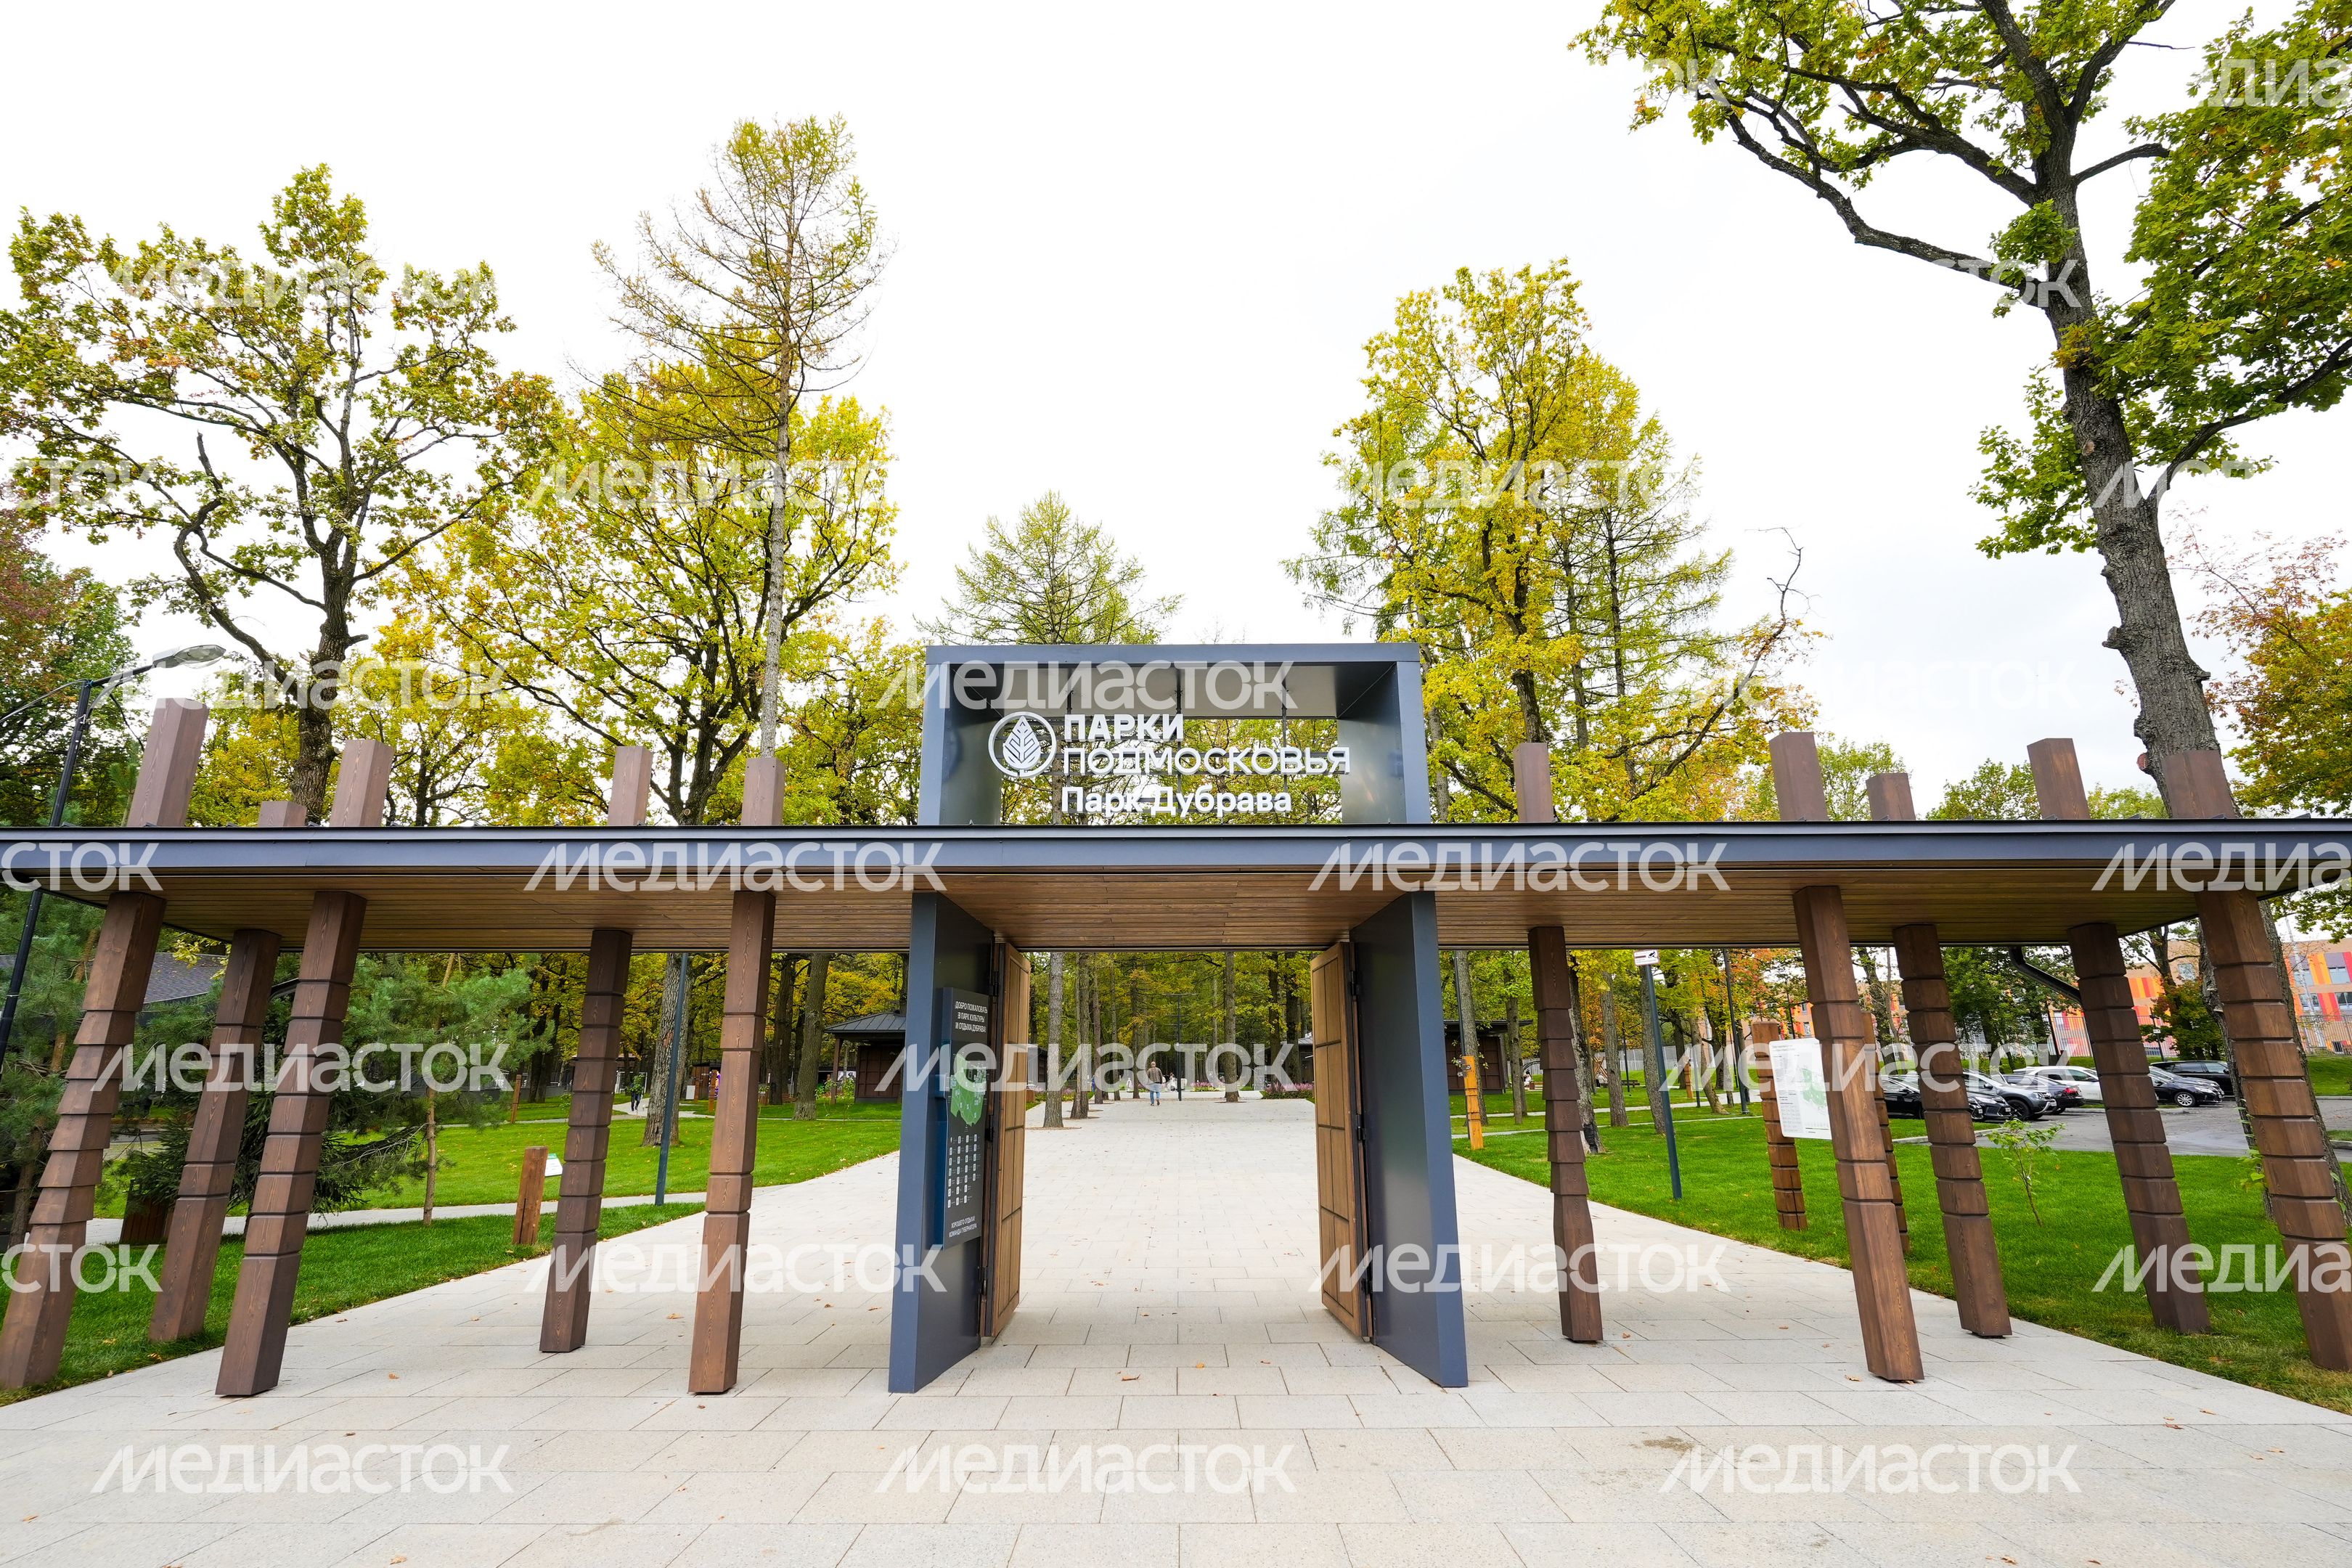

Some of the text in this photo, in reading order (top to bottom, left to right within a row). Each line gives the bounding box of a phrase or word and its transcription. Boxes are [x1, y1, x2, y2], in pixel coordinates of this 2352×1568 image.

[1064, 714, 1184, 741] ПАРКИ
[1063, 746, 1350, 775] ПОДМОСКОВЬЯ
[1061, 784, 1291, 818] Парк Дубрава
